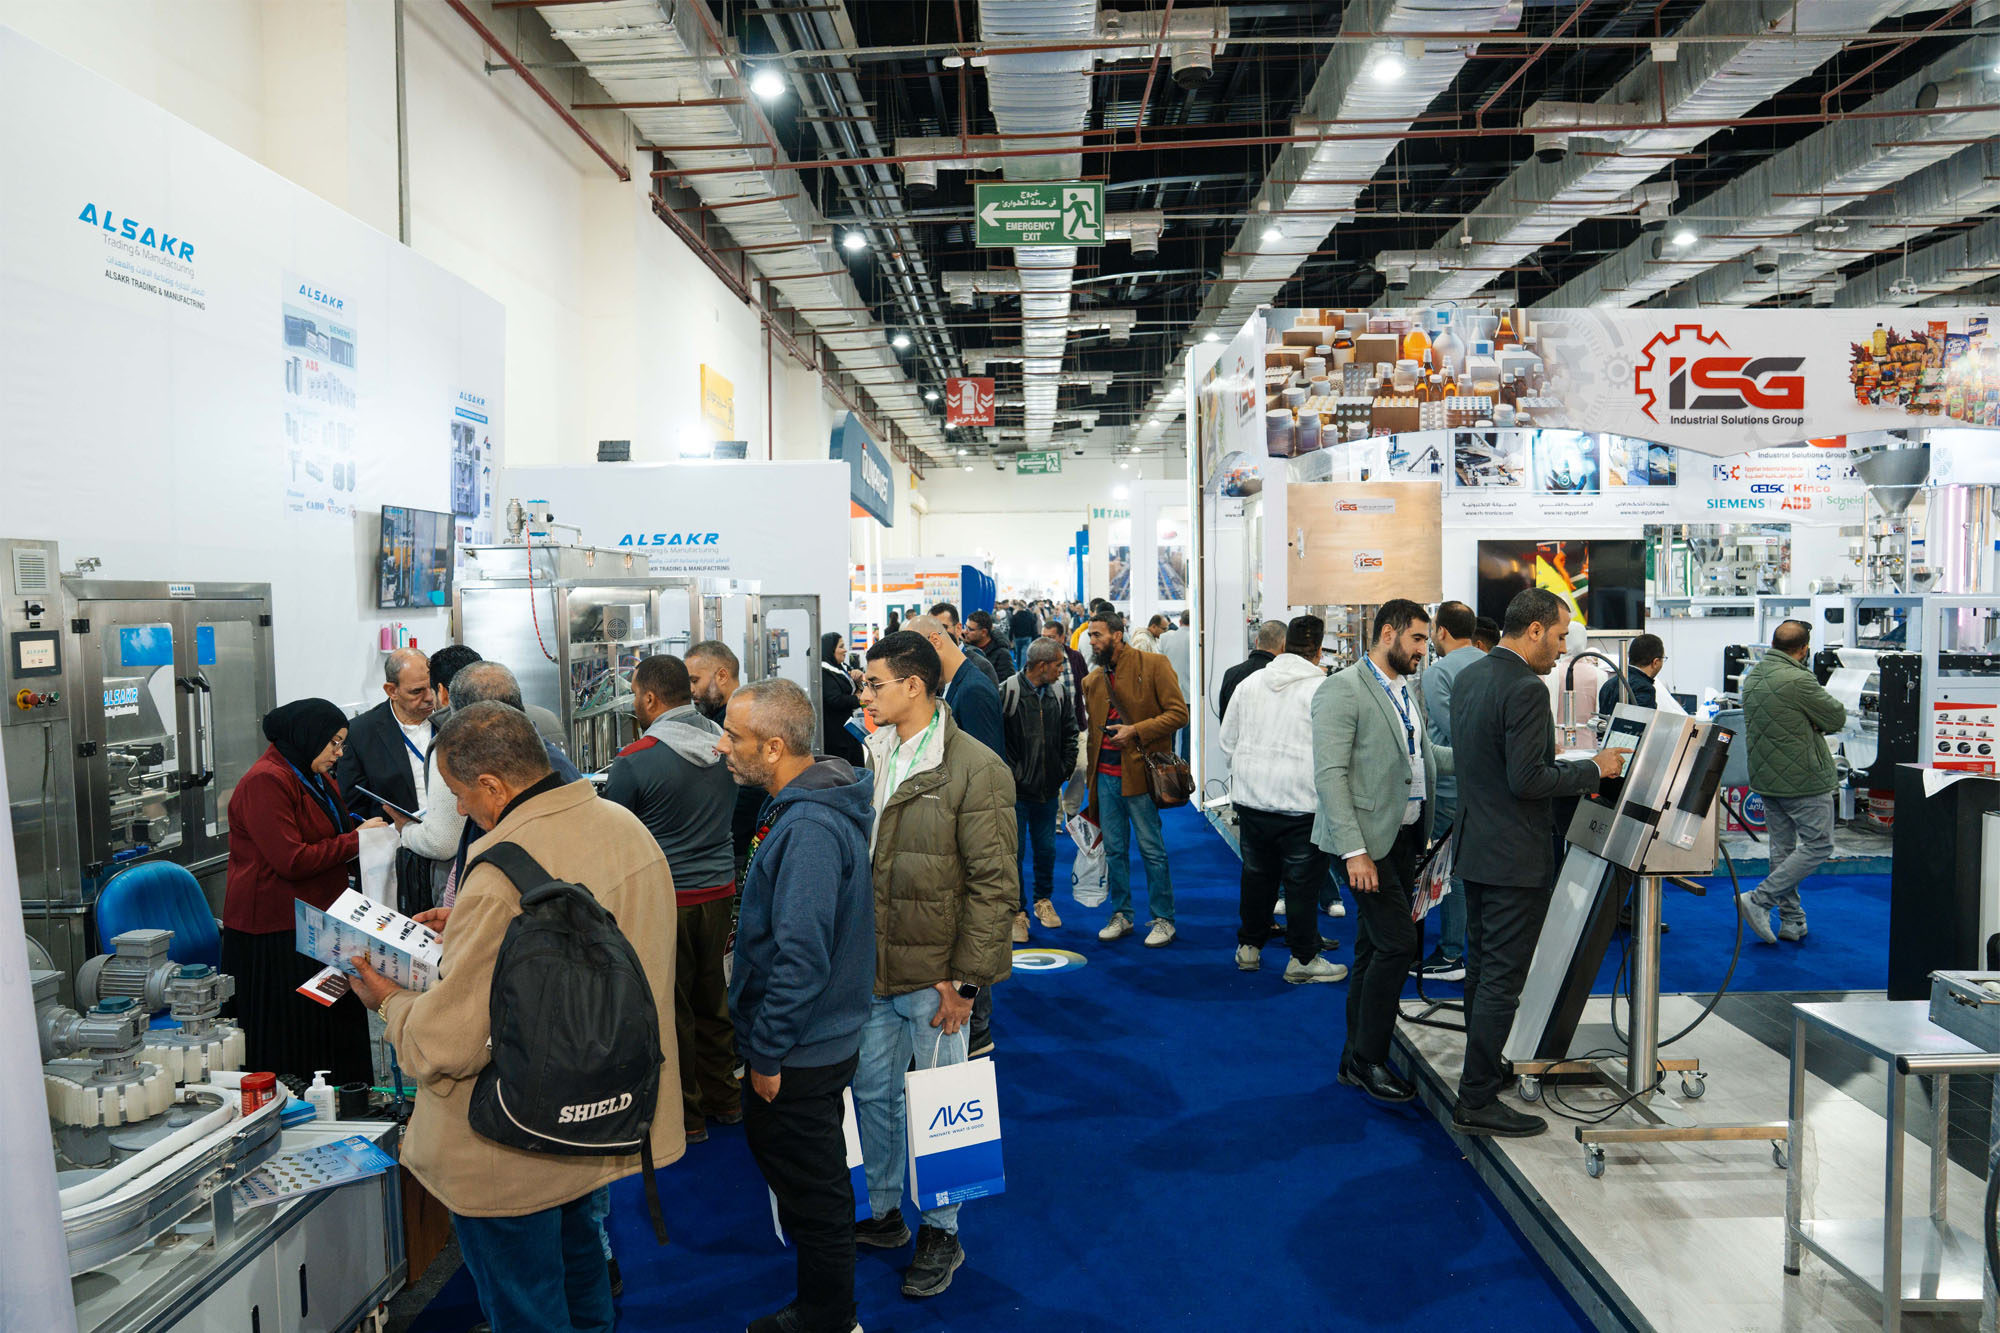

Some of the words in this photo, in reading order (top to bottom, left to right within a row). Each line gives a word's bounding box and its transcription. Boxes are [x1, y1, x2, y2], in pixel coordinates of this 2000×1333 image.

[1020, 189, 1040, 199] خروج
[1030, 199, 1048, 207] حالة
[78, 202, 195, 263] ALSAKR
[1005, 221, 1056, 231] EMERGENCY
[1022, 232, 1041, 241] EXIT
[103, 233, 134, 257] Trading
[134, 245, 141, 256] &
[142, 248, 195, 280] Manufacturing
[104, 269, 130, 285] ALSAKR
[131, 277, 158, 294] TRADING
[158, 287, 164, 296] &
[298, 284, 344, 310] ALSAKR
[459, 391, 486, 406] ALSAKR
[1670, 414, 1719, 426] Industrial
[1720, 414, 1770, 426] Solutions
[1772, 414, 1804, 428] Group
[1757, 451, 1790, 459] Industrial
[1791, 451, 1824, 459] Solutions
[1825, 451, 1848, 460] Group
[1793, 484, 1831, 493] Kinco
[1706, 498, 1766, 509] SIEMENS
[1780, 496, 1812, 510] ABB
[618, 532, 720, 546] ALSAKR
[670, 546, 720, 555] Manufacturing
[558, 1092, 633, 1124] SHIELD
[928, 1098, 984, 1131] AKS
[928, 1130, 951, 1139] INNOVATE
